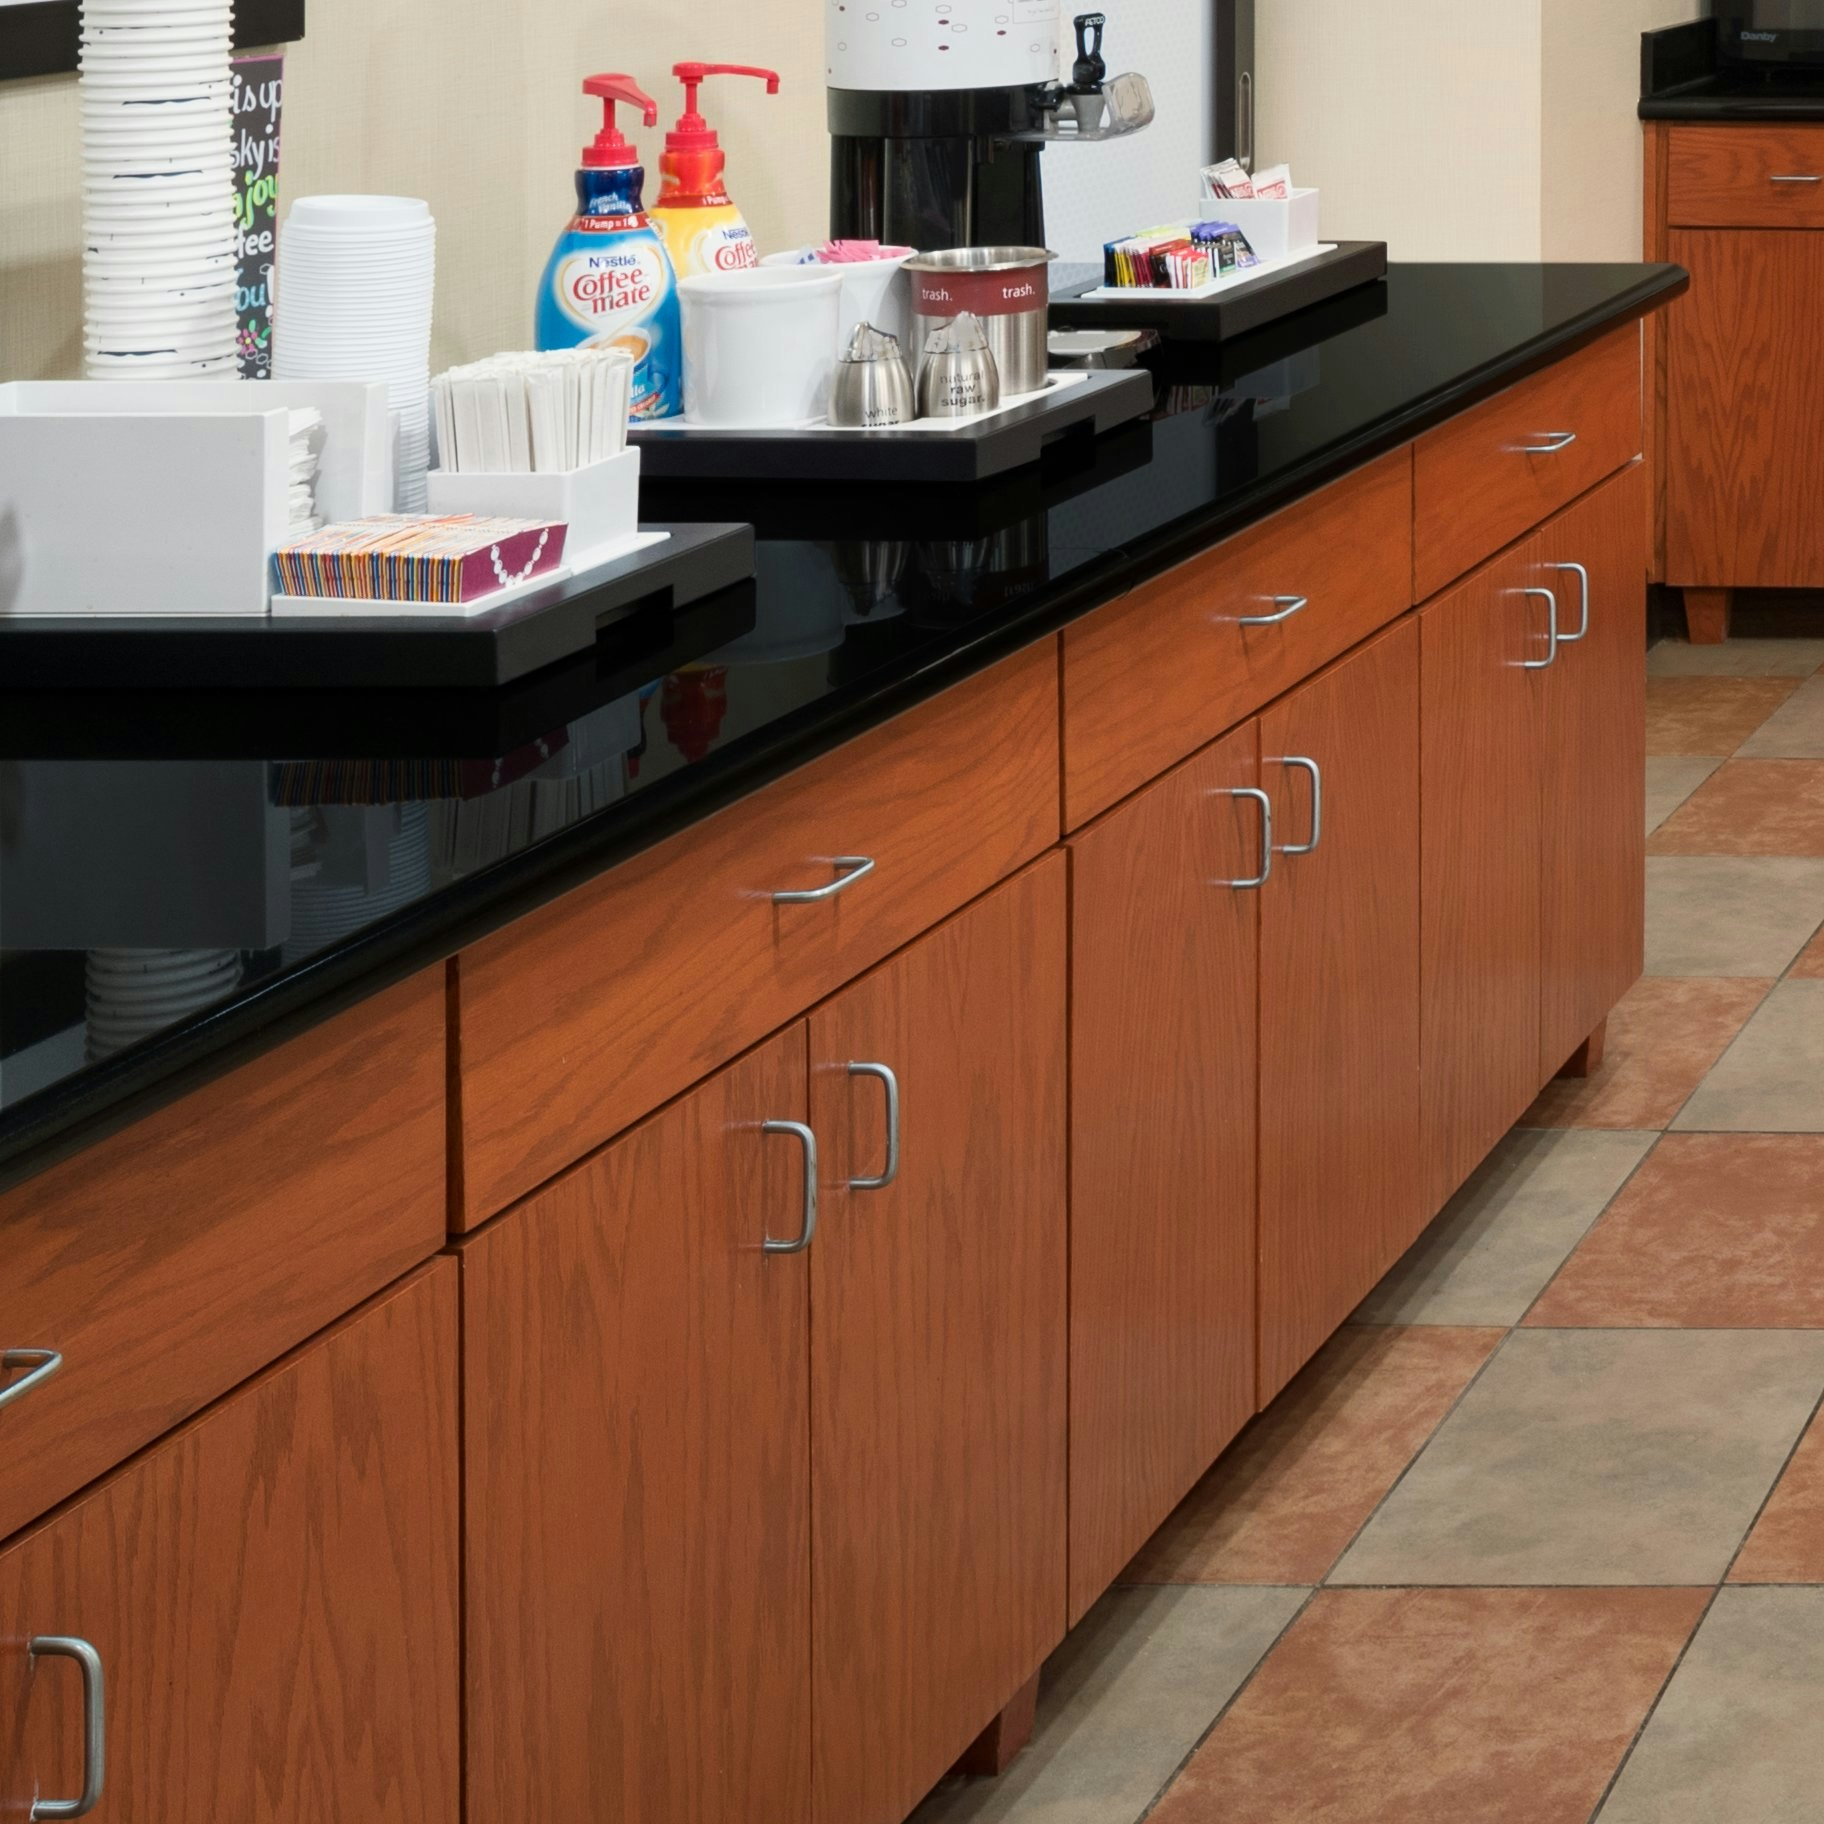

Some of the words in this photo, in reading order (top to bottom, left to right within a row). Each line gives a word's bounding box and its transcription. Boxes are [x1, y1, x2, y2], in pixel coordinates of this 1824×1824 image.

[1741, 31, 1777, 43] Danby
[233, 74, 256, 114] is
[260, 78, 283, 123] up
[573, 268, 643, 302] Coffee
[1002, 283, 1036, 299] trash.
[592, 284, 650, 314] mate
[922, 288, 953, 302] trash.
[950, 384, 977, 393] raw
[941, 394, 986, 408] sugar.
[865, 405, 898, 419] white
